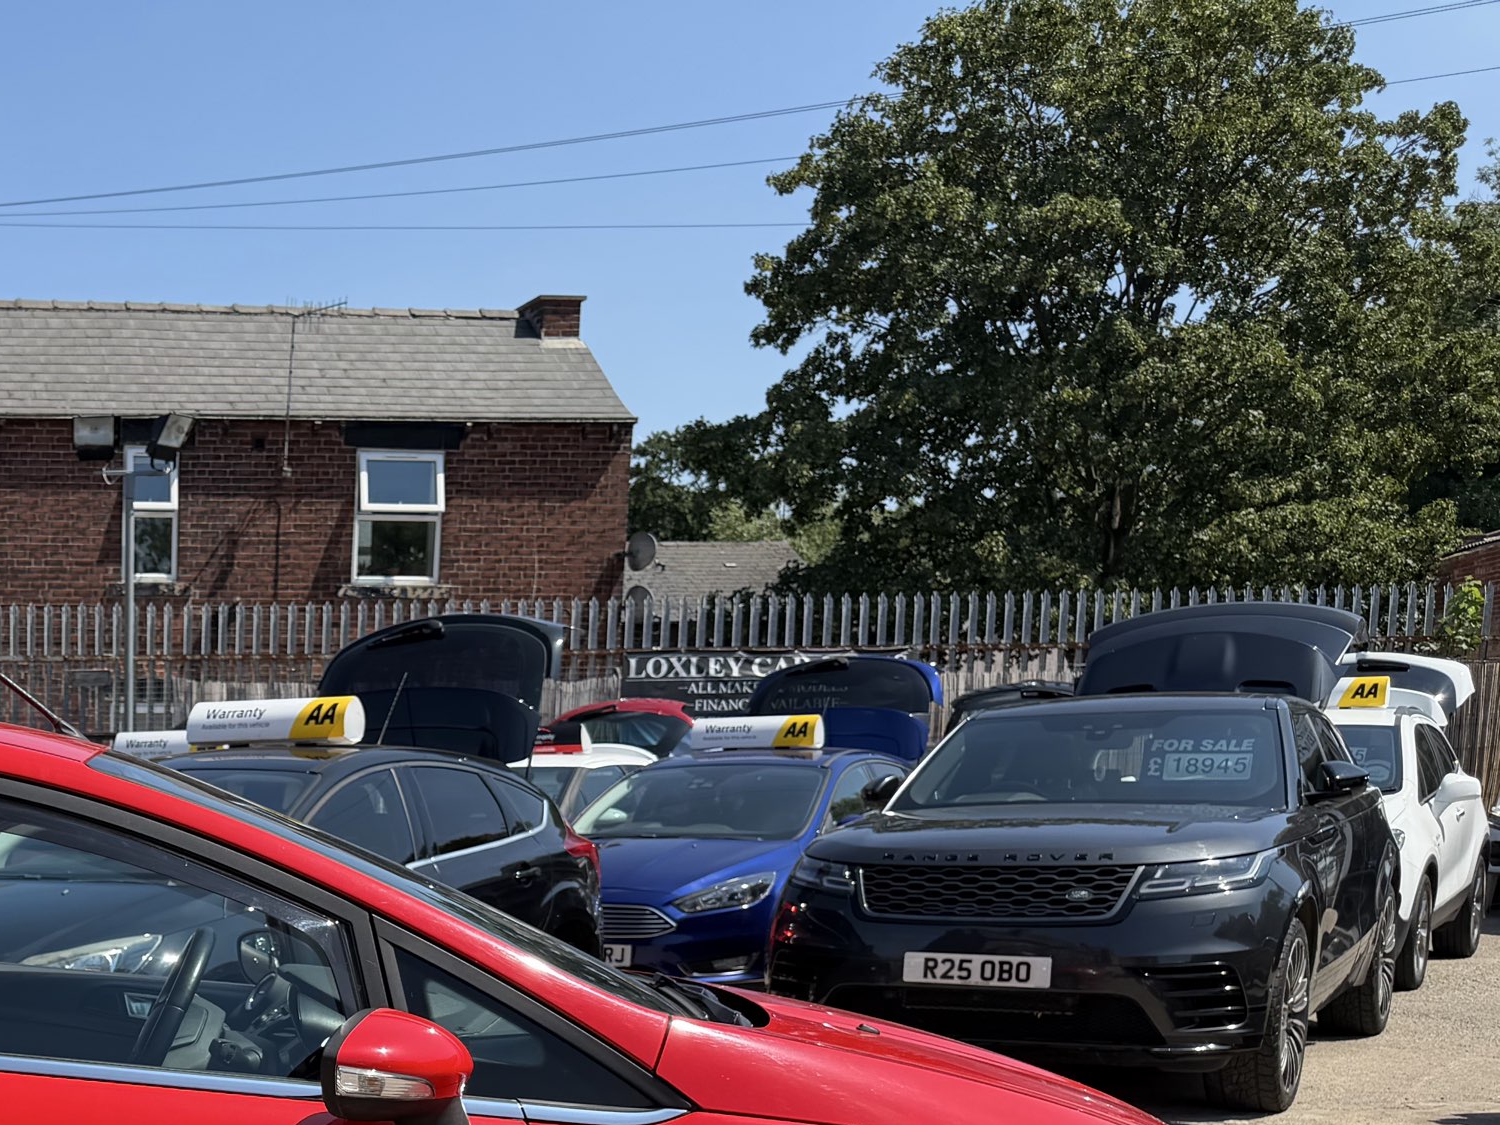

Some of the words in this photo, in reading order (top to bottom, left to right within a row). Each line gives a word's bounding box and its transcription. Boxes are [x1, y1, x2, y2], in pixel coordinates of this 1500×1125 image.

[627, 656, 747, 679] LOXLEY
[1351, 683, 1379, 699] AA
[694, 699, 750, 711] FINANC
[206, 707, 266, 720] Warranty
[304, 703, 339, 726] AA
[705, 723, 753, 734] Warranty
[783, 722, 809, 738] AA
[125, 739, 169, 749] Warranty
[1151, 739, 1195, 751] FOR
[1200, 738, 1256, 751] SALE
[1173, 757, 1248, 774] 18945
[883, 853, 980, 862] RANGE
[1003, 853, 1114, 862] ROVER
[923, 957, 972, 980] R25
[980, 960, 1031, 983] OBO
